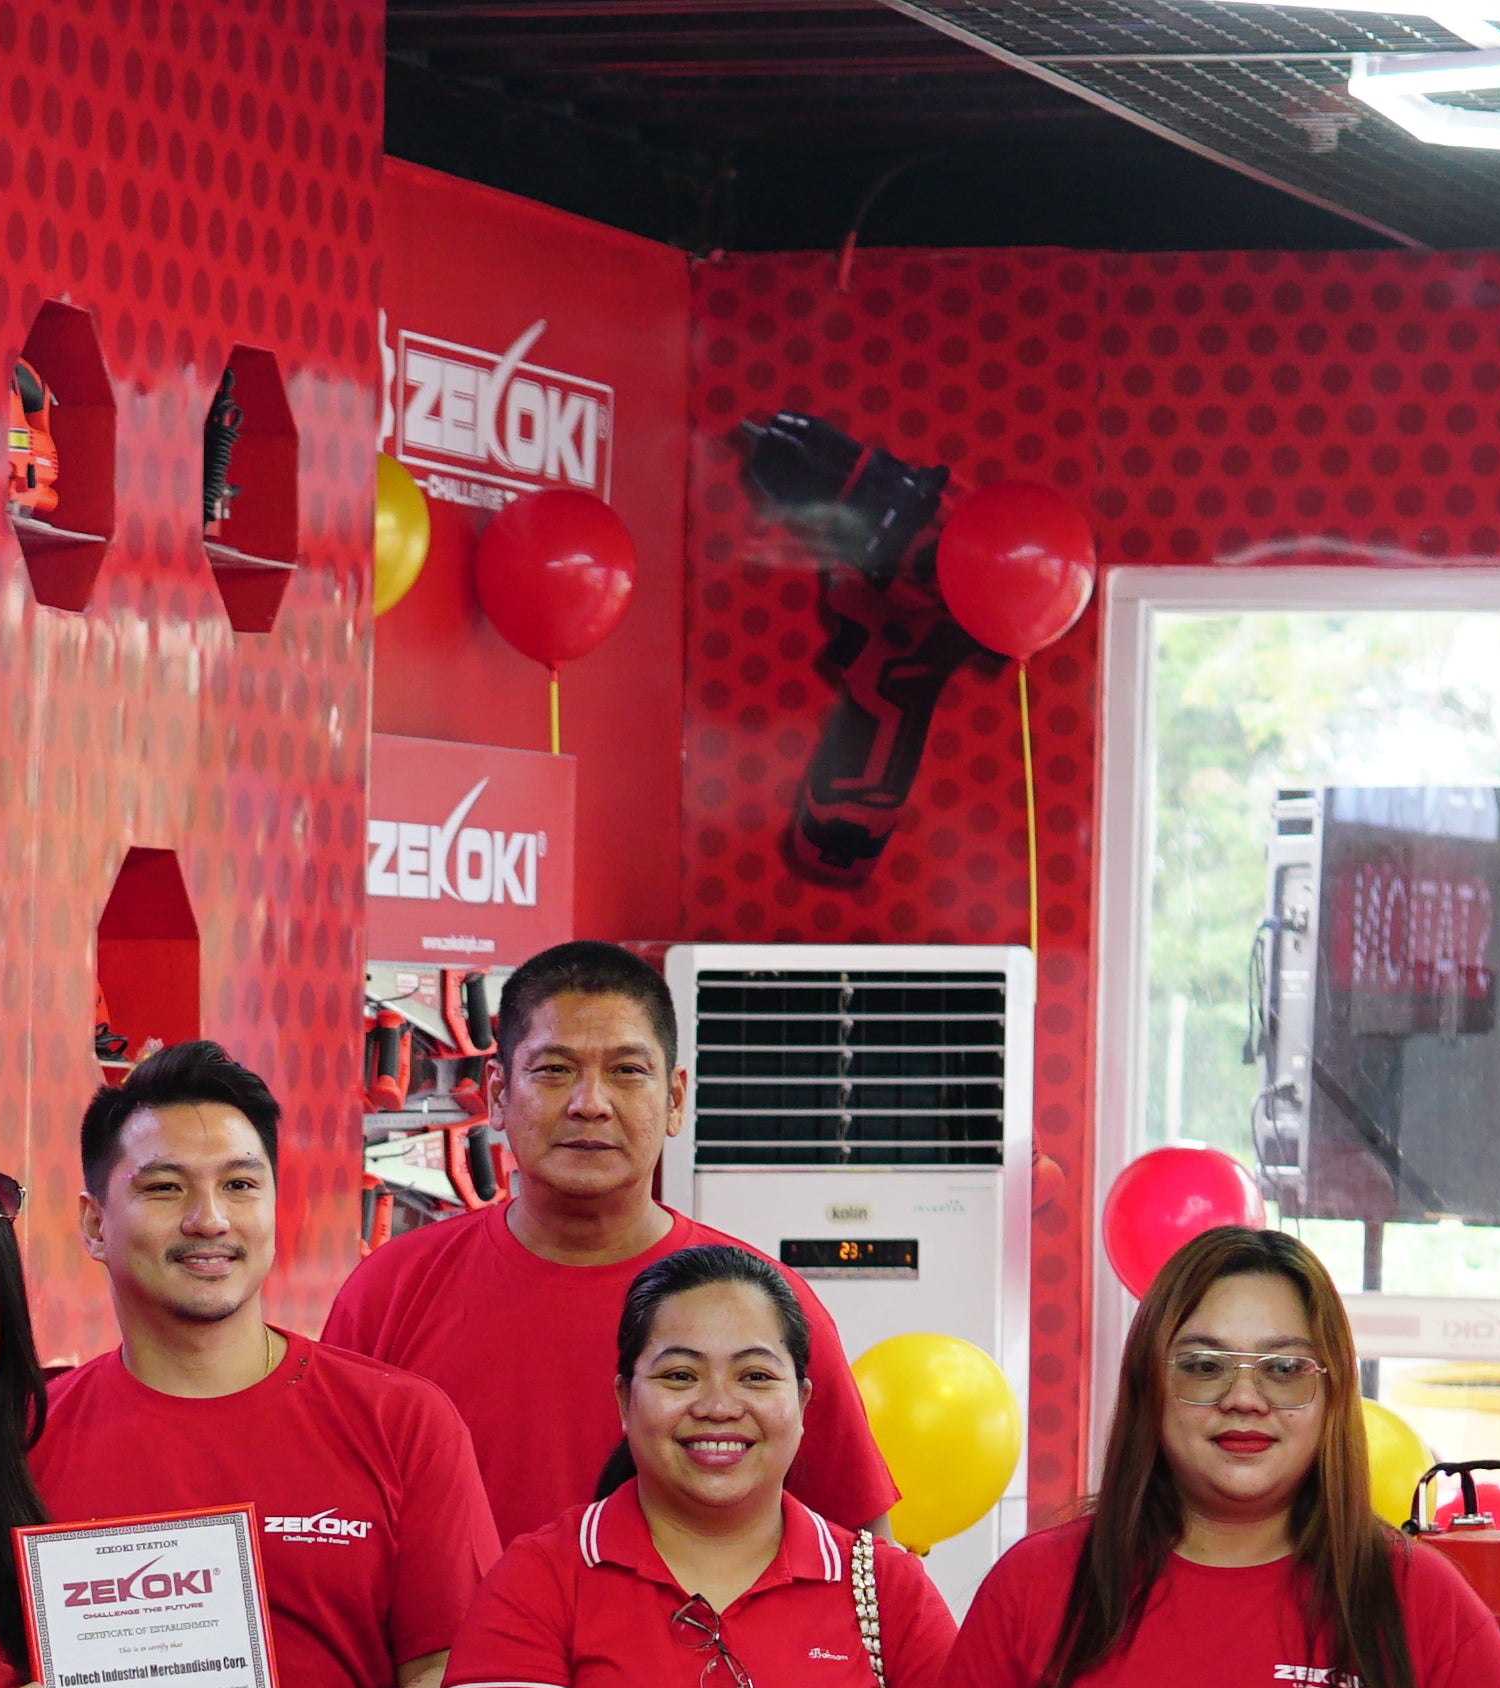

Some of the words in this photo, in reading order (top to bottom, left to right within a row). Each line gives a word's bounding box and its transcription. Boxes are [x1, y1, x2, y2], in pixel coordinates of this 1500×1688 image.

[831, 1205, 868, 1222] kolin
[96, 1544, 134, 1555] ZEKOKI
[135, 1540, 178, 1551] STATION
[83, 1608, 140, 1620] CHALLENGE
[142, 1606, 163, 1614] THE
[165, 1602, 204, 1612] FUTURE
[77, 1628, 135, 1641] CERTIFICATE
[136, 1626, 149, 1636] OF
[149, 1620, 221, 1635] ESTABLISHMENT
[58, 1670, 101, 1687] Tooltech
[102, 1666, 149, 1683] Industrial
[150, 1660, 222, 1678] Merchandising
